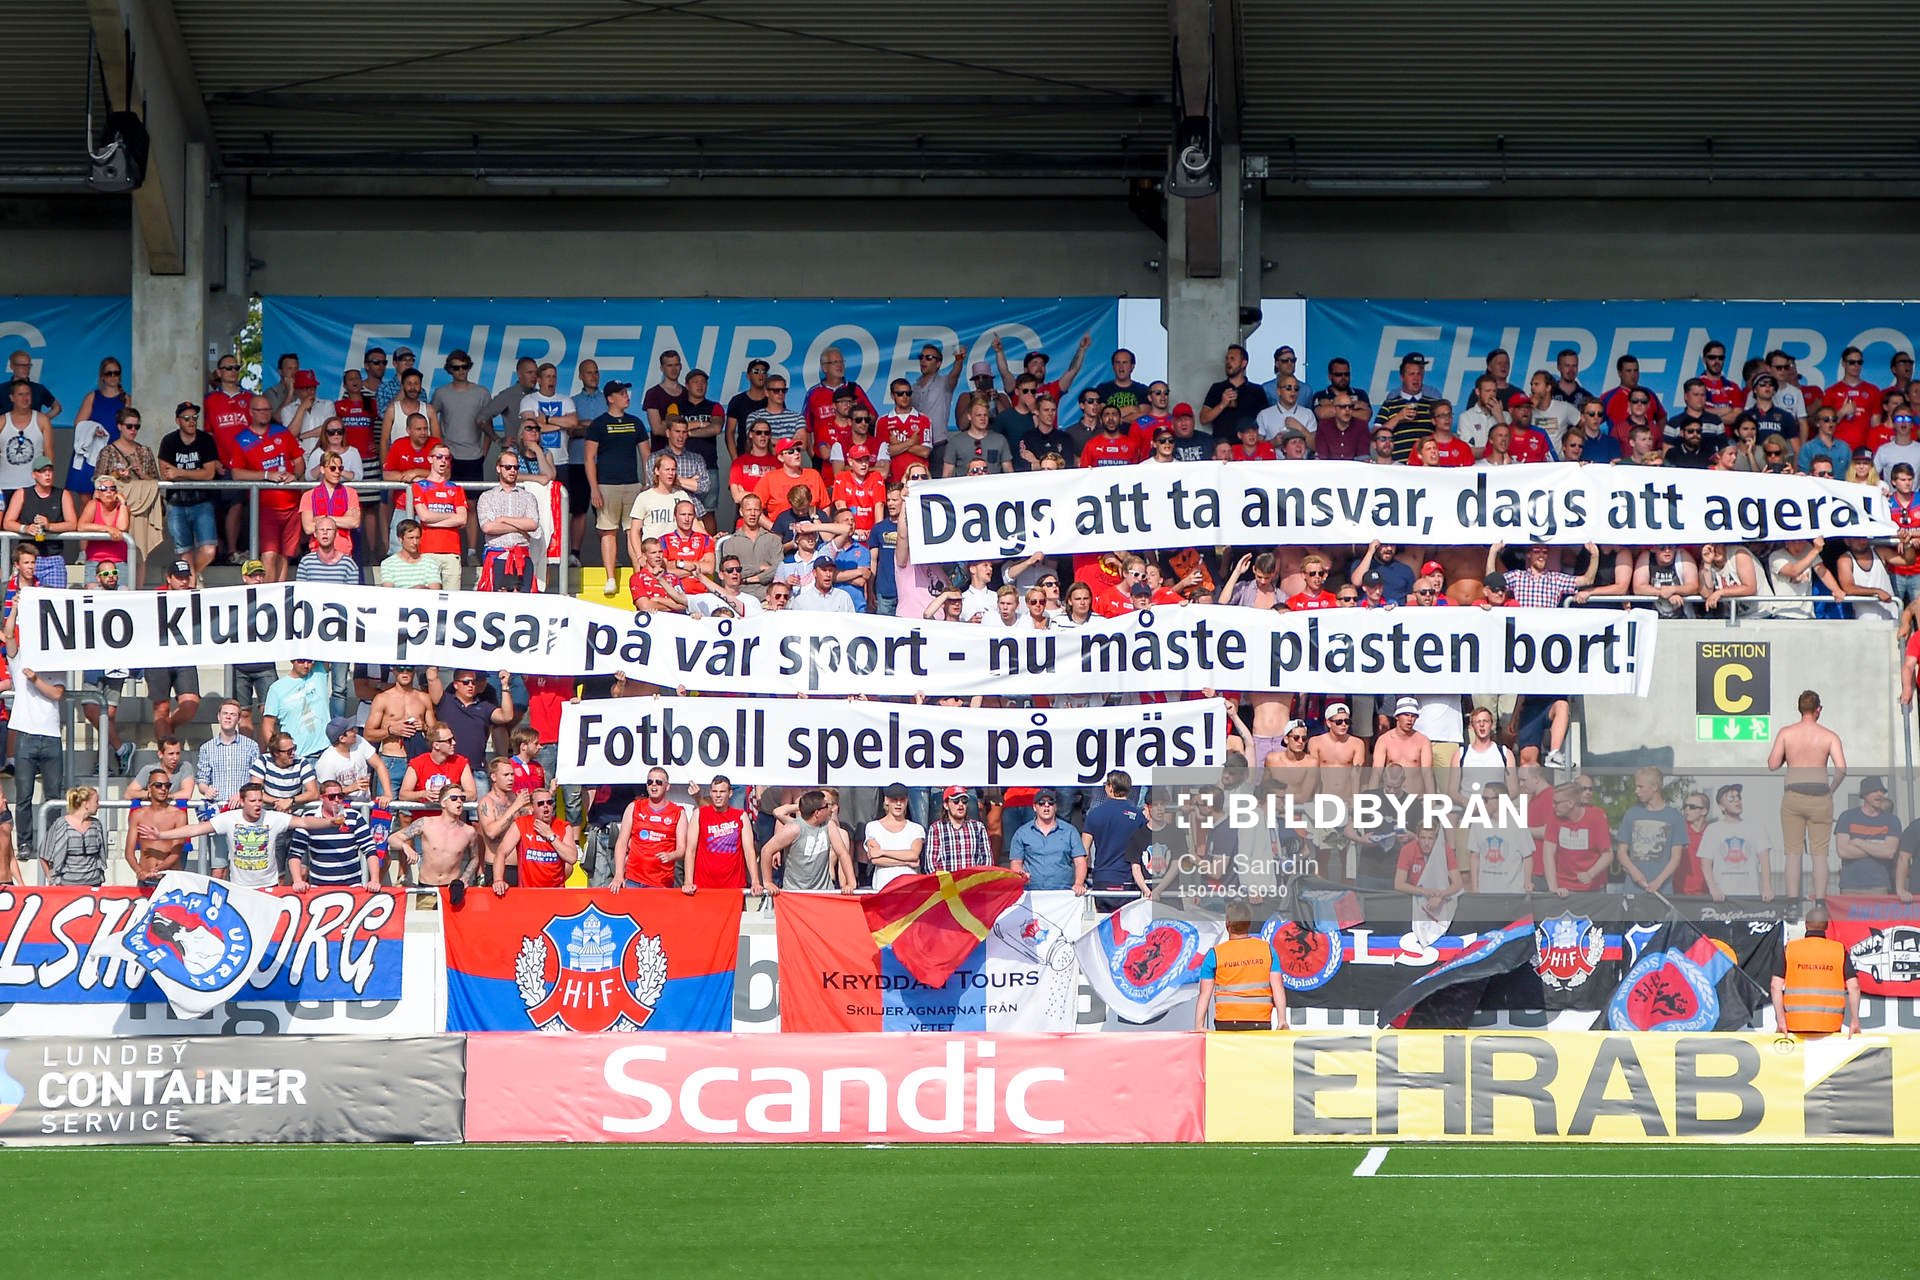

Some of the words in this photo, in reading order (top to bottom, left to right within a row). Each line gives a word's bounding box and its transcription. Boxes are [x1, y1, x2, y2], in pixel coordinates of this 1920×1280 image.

[651, 509, 675, 525] ITAL
[919, 493, 1054, 556] Dags
[1075, 482, 1152, 535] att
[1167, 480, 1221, 529] ta
[1241, 484, 1433, 536] ansvar,
[1456, 472, 1586, 541] dags
[1608, 482, 1685, 530] att
[38, 595, 134, 650] Nio
[157, 585, 377, 647] klubbar
[396, 593, 569, 660] pissar
[585, 610, 651, 671] på
[675, 618, 761, 677] vår
[779, 627, 928, 690] sport
[948, 652, 966, 661] -
[989, 634, 1056, 675] nu
[1081, 609, 1247, 674] måste
[1270, 616, 1480, 687] plasten
[1504, 616, 1637, 675] bort!
[1702, 644, 1766, 658] SEKTION
[1713, 663, 1753, 713] C
[576, 708, 764, 767] Fotboll
[787, 711, 964, 784] spelas
[987, 713, 1053, 784] på
[1075, 711, 1215, 784] gräs!
[822, 971, 946, 991] KRYDDA
[43, 1043, 188, 1067] LUNDBY
[602, 1040, 1064, 1134] Scandic
[1293, 1035, 1765, 1137] EHRAB
[41, 1109, 181, 1134] SERVICE
